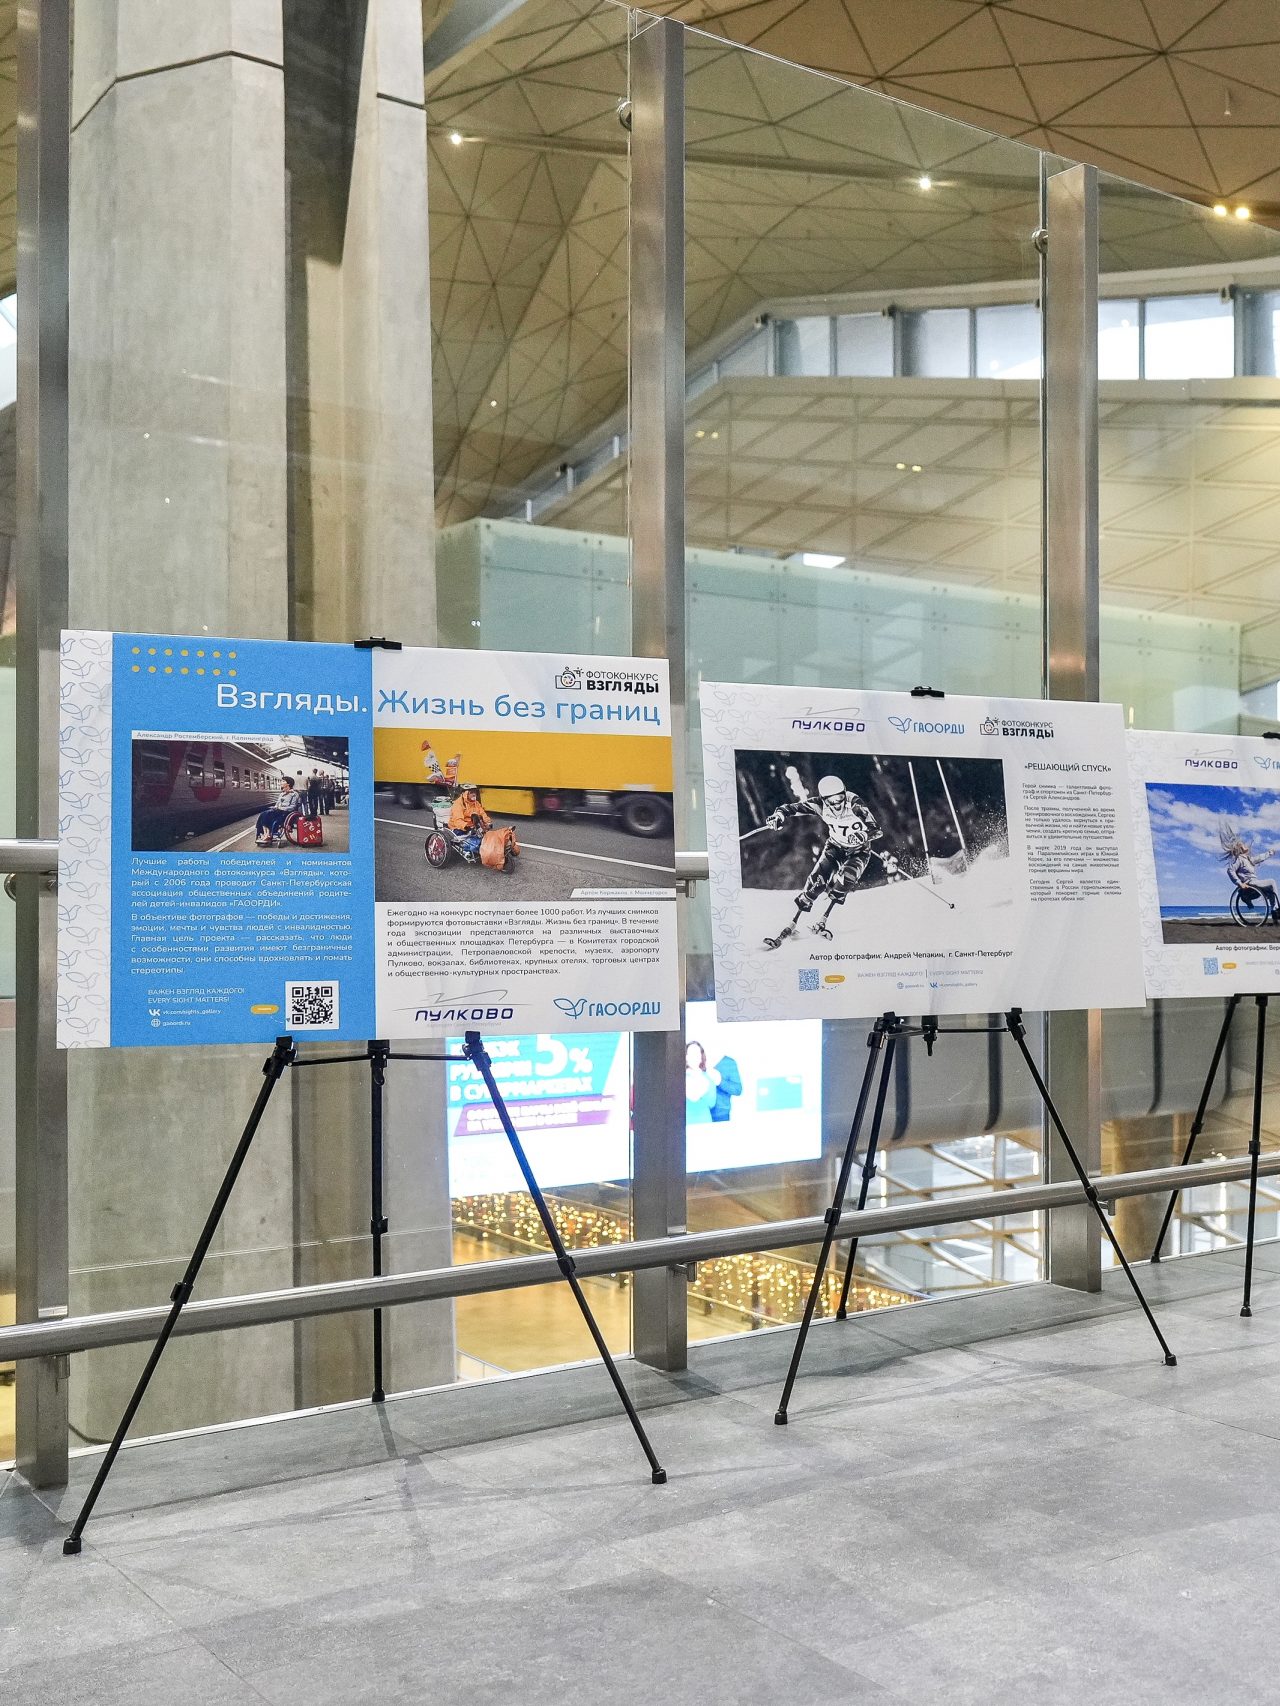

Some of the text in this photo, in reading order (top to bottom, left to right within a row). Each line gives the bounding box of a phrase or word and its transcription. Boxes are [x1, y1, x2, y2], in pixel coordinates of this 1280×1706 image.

[586, 670, 658, 682] ФОТОКОНКУРС
[586, 681, 659, 694] ВЗГЛЯДЫ
[217, 683, 660, 726] Взгляды. Жизнь без границ
[792, 720, 866, 732] ПУЛКОВО
[913, 722, 965, 734] ГАООРДИ
[1002, 720, 1053, 728] ФОТОКОНКУРС
[1002, 728, 1054, 740] ВЗГЛЯДЫ
[1024, 763, 1111, 772] «РЕШАЮЩИЙ СПУСК»
[1185, 758, 1238, 769] ПУЛКОВО
[131, 857, 167, 867] Лучшие
[177, 857, 209, 867] работы
[220, 857, 276, 867] победителей
[131, 867, 209, 878] Международного
[213, 868, 275, 878] фотоконкурса
[131, 878, 149, 888] рый
[163, 878, 186, 886] 2006
[260, 878, 352, 888] Санкт-Петербургская
[188, 888, 252, 898] общественных
[256, 888, 314, 898] объединений
[131, 898, 282, 908] лей детей-инвалидов «ГАООРДИ».
[140, 912, 186, 920] объективе
[188, 912, 243, 922] фотографов
[257, 912, 289, 922] победы
[298, 914, 352, 922] достижения,
[387, 908, 427, 917] Ежегодно
[514, 907, 538, 915] более
[540, 907, 559, 915] 1000
[561, 907, 584, 917] работ.
[585, 907, 596, 915] Из
[131, 925, 166, 933] эмоции,
[246, 922, 274, 932] людей
[387, 918, 443, 928] формируются
[445, 917, 502, 927] фотовыставки
[504, 917, 543, 927] «Взгляды.
[544, 917, 571, 925] Жизнь
[572, 917, 586, 925] без
[131, 933, 166, 942] Главная
[255, 935, 304, 943] рассказать,
[387, 930, 406, 938] года
[414, 930, 461, 938] экспозиции
[141, 943, 208, 952] особенностями
[292, 942, 352, 953] безграничные
[396, 938, 456, 948] общественных
[508, 937, 553, 947] Петербурга
[577, 936, 617, 944] Комитетах
[620, 936, 659, 946] городской
[387, 950, 453, 958] администрации,
[461, 947, 531, 957] Петропавловской
[584, 948, 613, 956] музеях,
[1215, 944, 1232, 952] Автор
[1232, 944, 1267, 952] фотографии:
[214, 954, 255, 962] способны
[809, 953, 832, 962] Автор
[833, 952, 882, 962] фотографии:
[883, 951, 911, 961] Андрей
[954, 950, 1013, 960] Санкт-Петербург
[387, 958, 424, 968] Пулково,
[427, 960, 466, 968] вокзалах,
[468, 957, 522, 967] библиотеках,
[560, 958, 588, 966] отелях,
[591, 958, 627, 966] торговых
[394, 967, 560, 978] общественно-культурных пространствах.
[589, 1002, 660, 1016] ГАООРДИ
[414, 1008, 514, 1022] ПУЛКОВО
